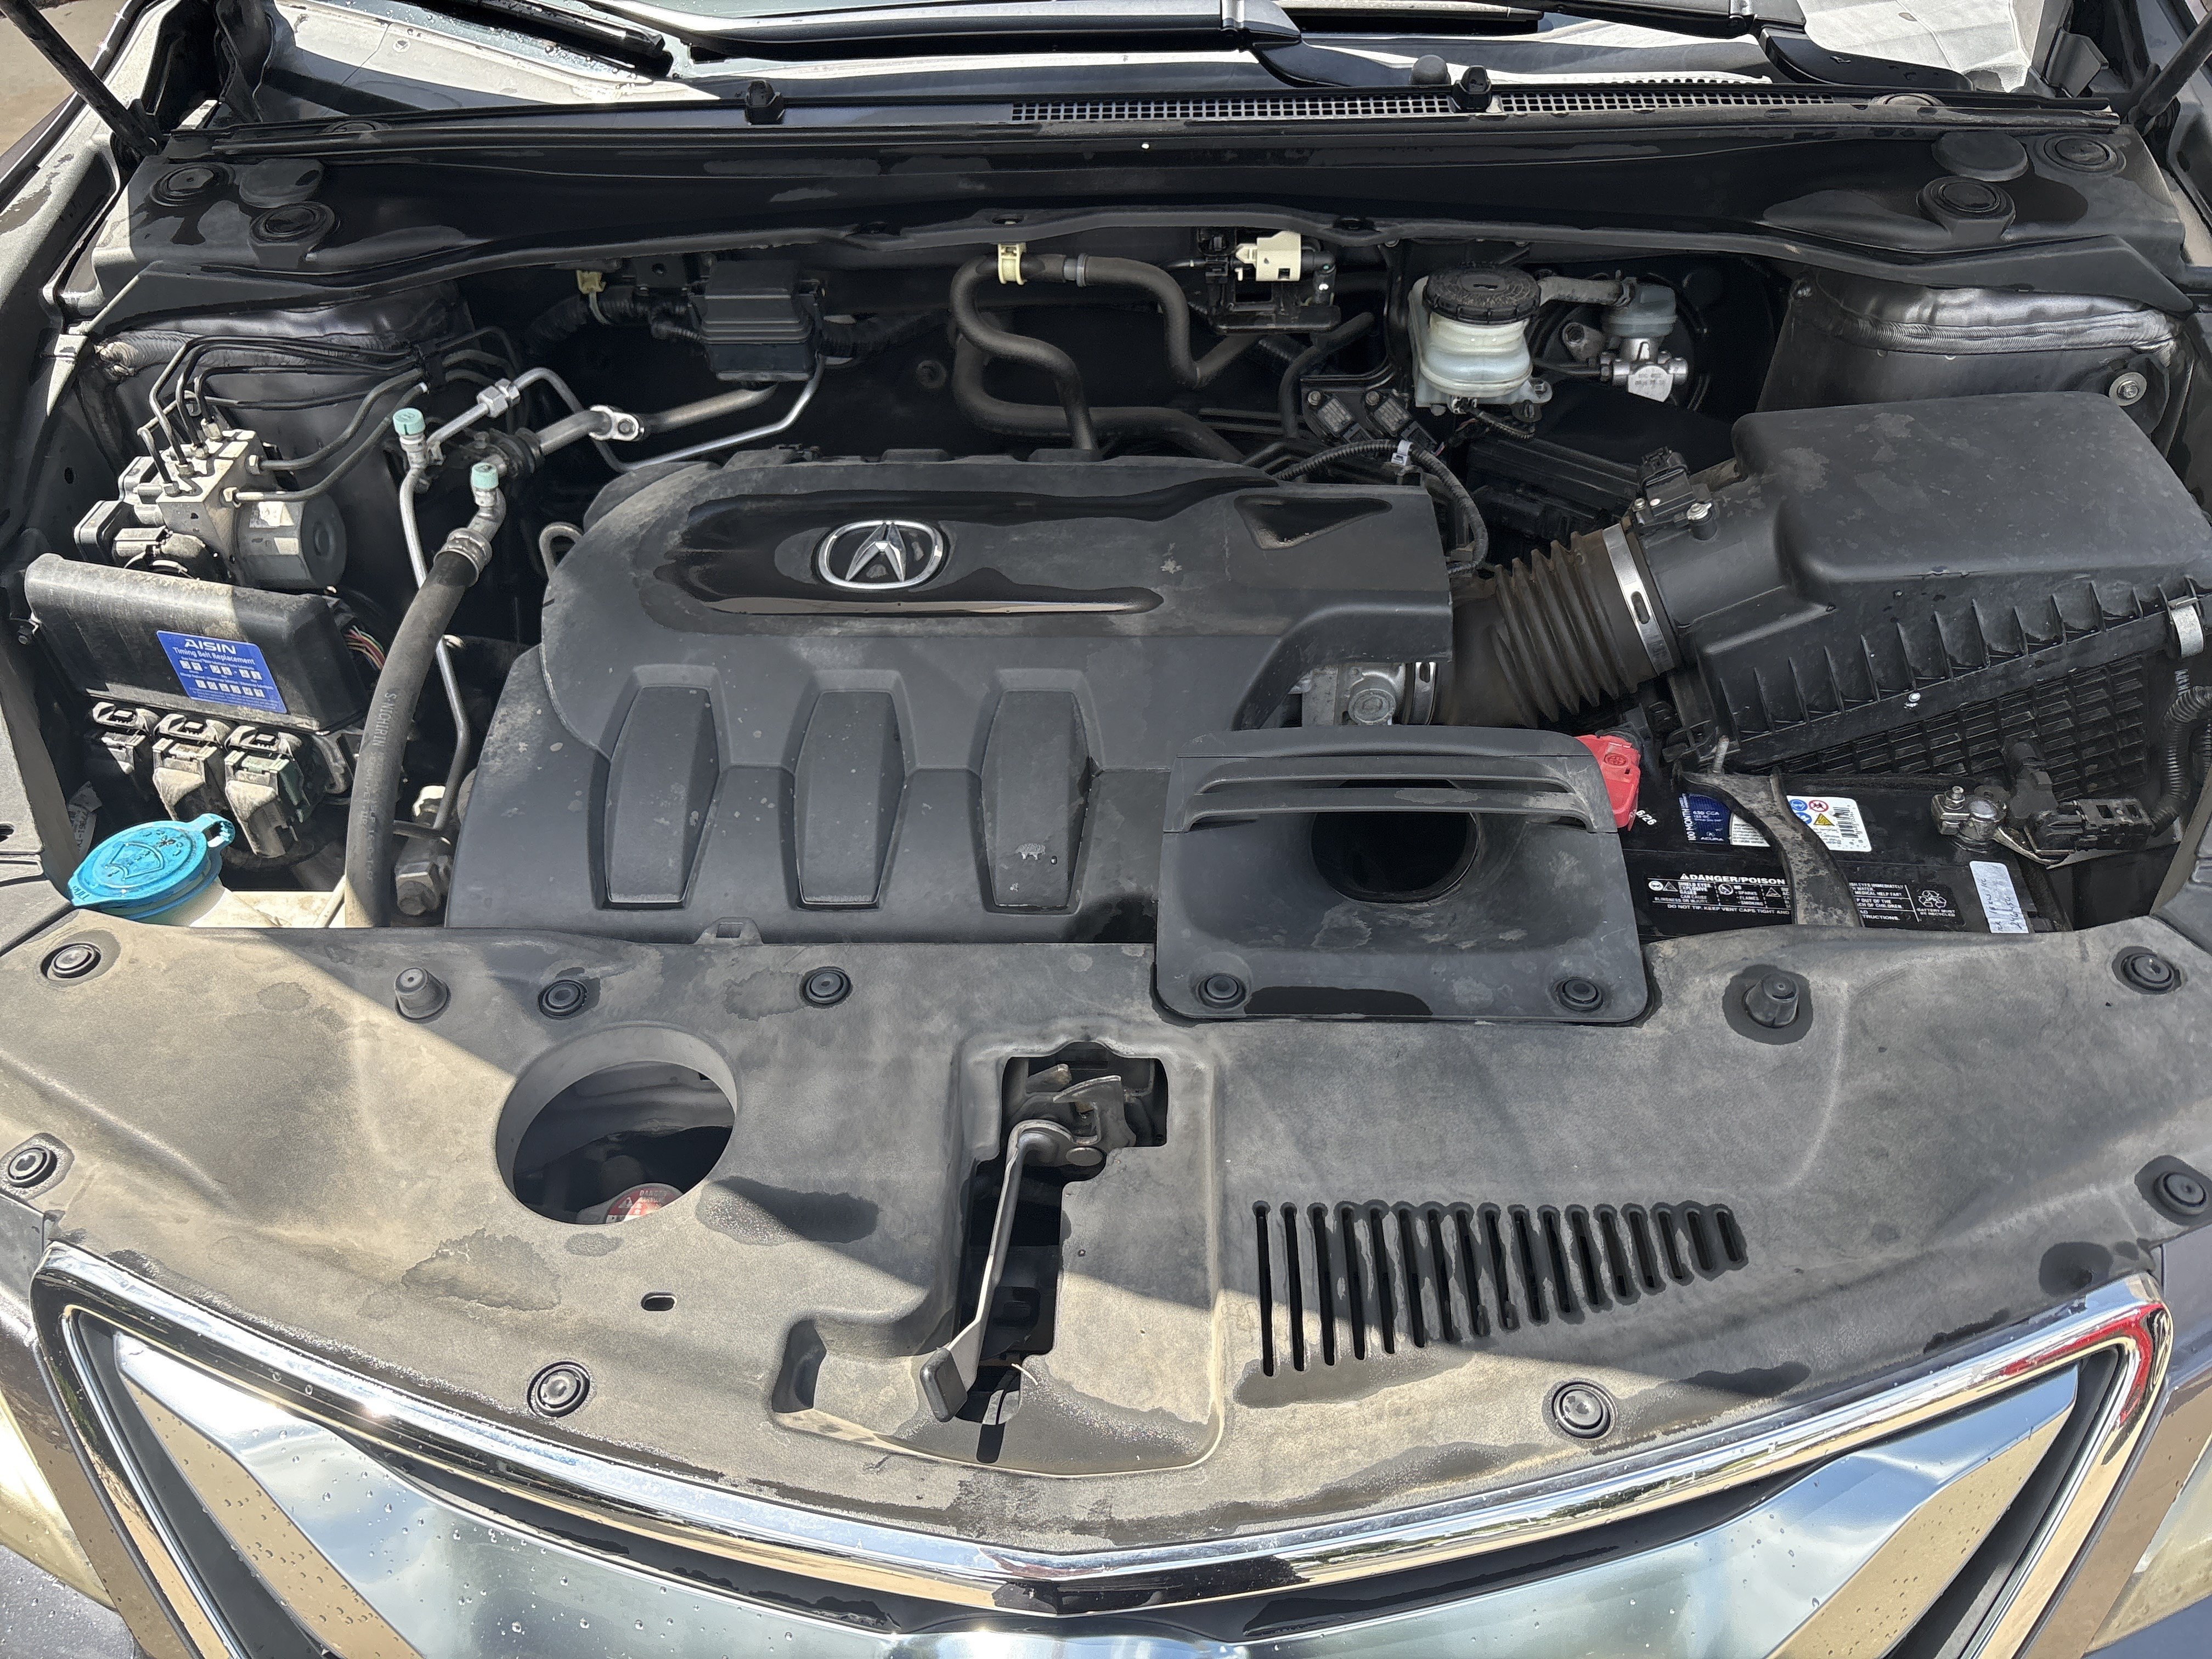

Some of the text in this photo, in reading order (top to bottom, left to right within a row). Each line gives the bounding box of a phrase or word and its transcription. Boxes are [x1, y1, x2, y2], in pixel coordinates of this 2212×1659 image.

[184, 638, 236, 655] AISIN
[172, 646, 197, 658] Timing
[198, 651, 211, 659] Belt
[212, 652, 256, 665] Replacement
[1681, 808, 1695, 831] MONTH
[1686, 831, 1697, 841] 100
[1689, 874, 1786, 885] DANGER/POISON
